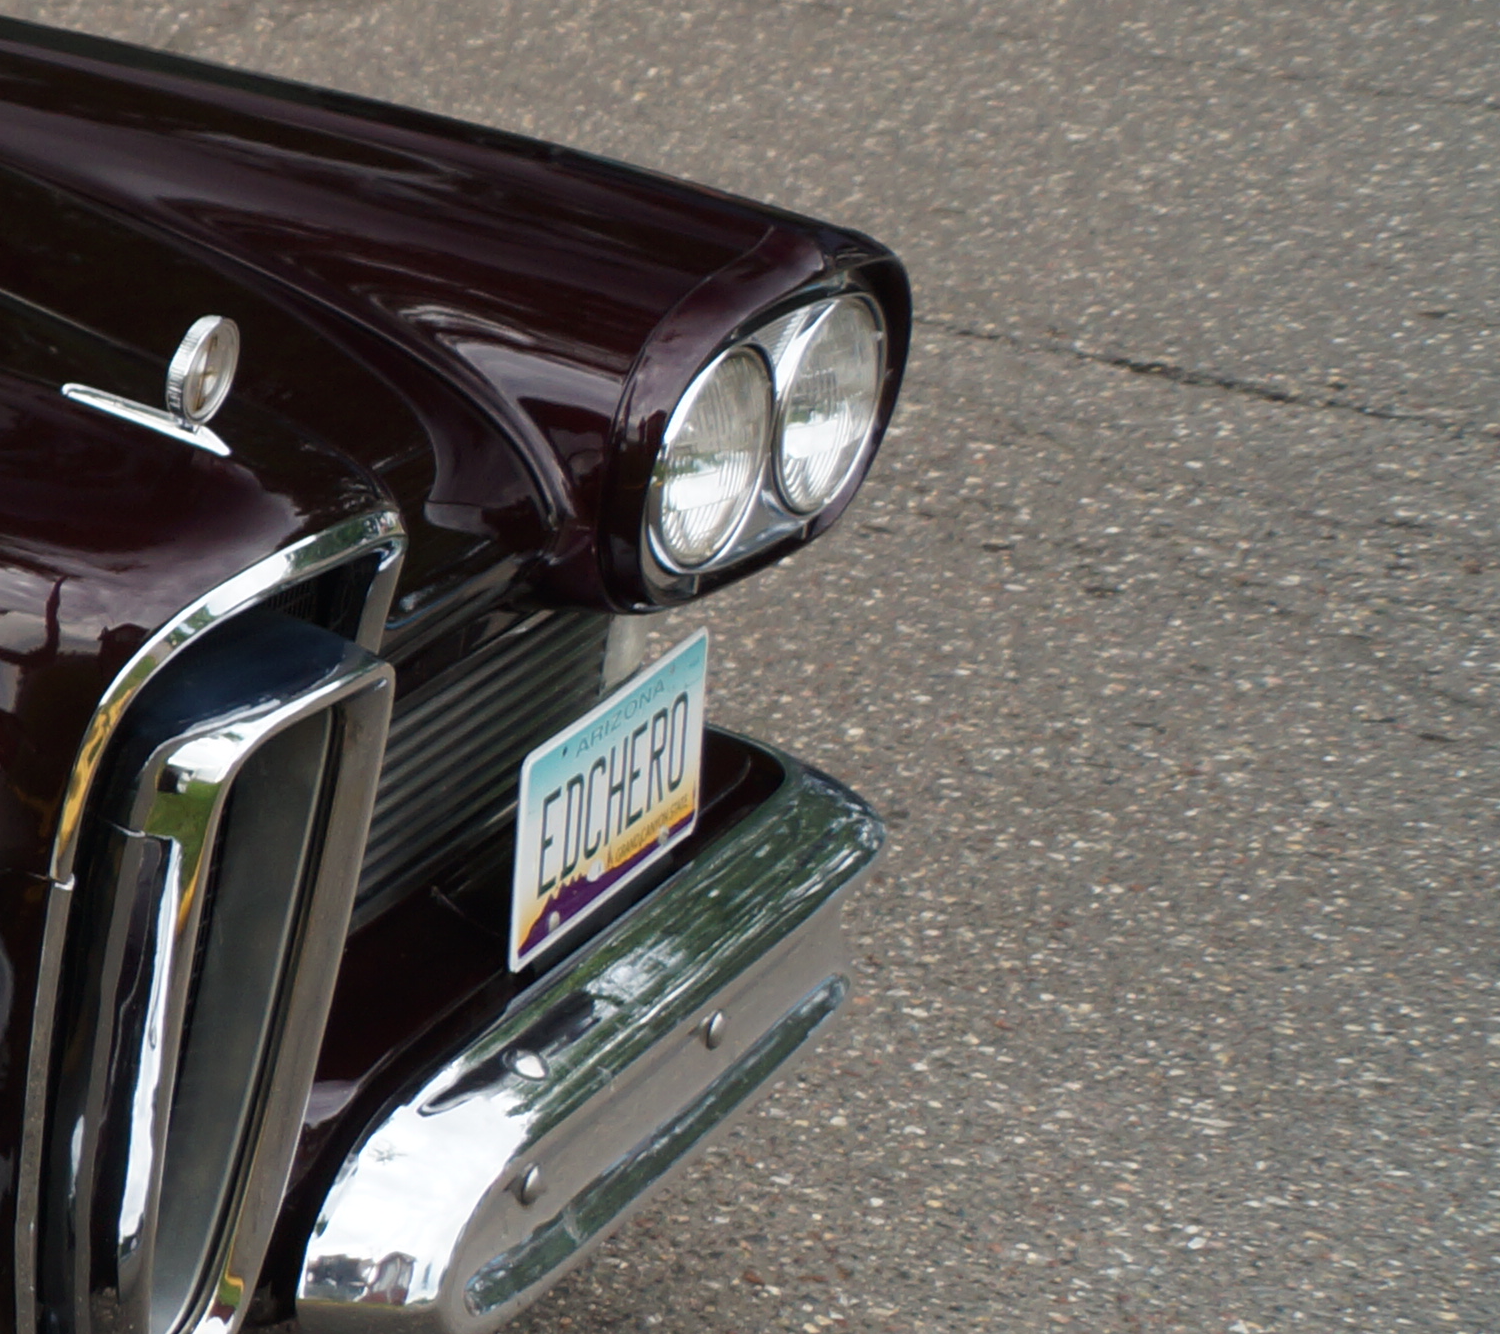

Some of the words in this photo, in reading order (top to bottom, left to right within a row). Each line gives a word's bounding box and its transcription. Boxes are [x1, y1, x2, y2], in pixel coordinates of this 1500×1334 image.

[575, 678, 667, 759] ARIZONA
[536, 691, 689, 900] EDCHERO
[614, 833, 641, 863] GRAND
[667, 793, 688, 817] STATE
